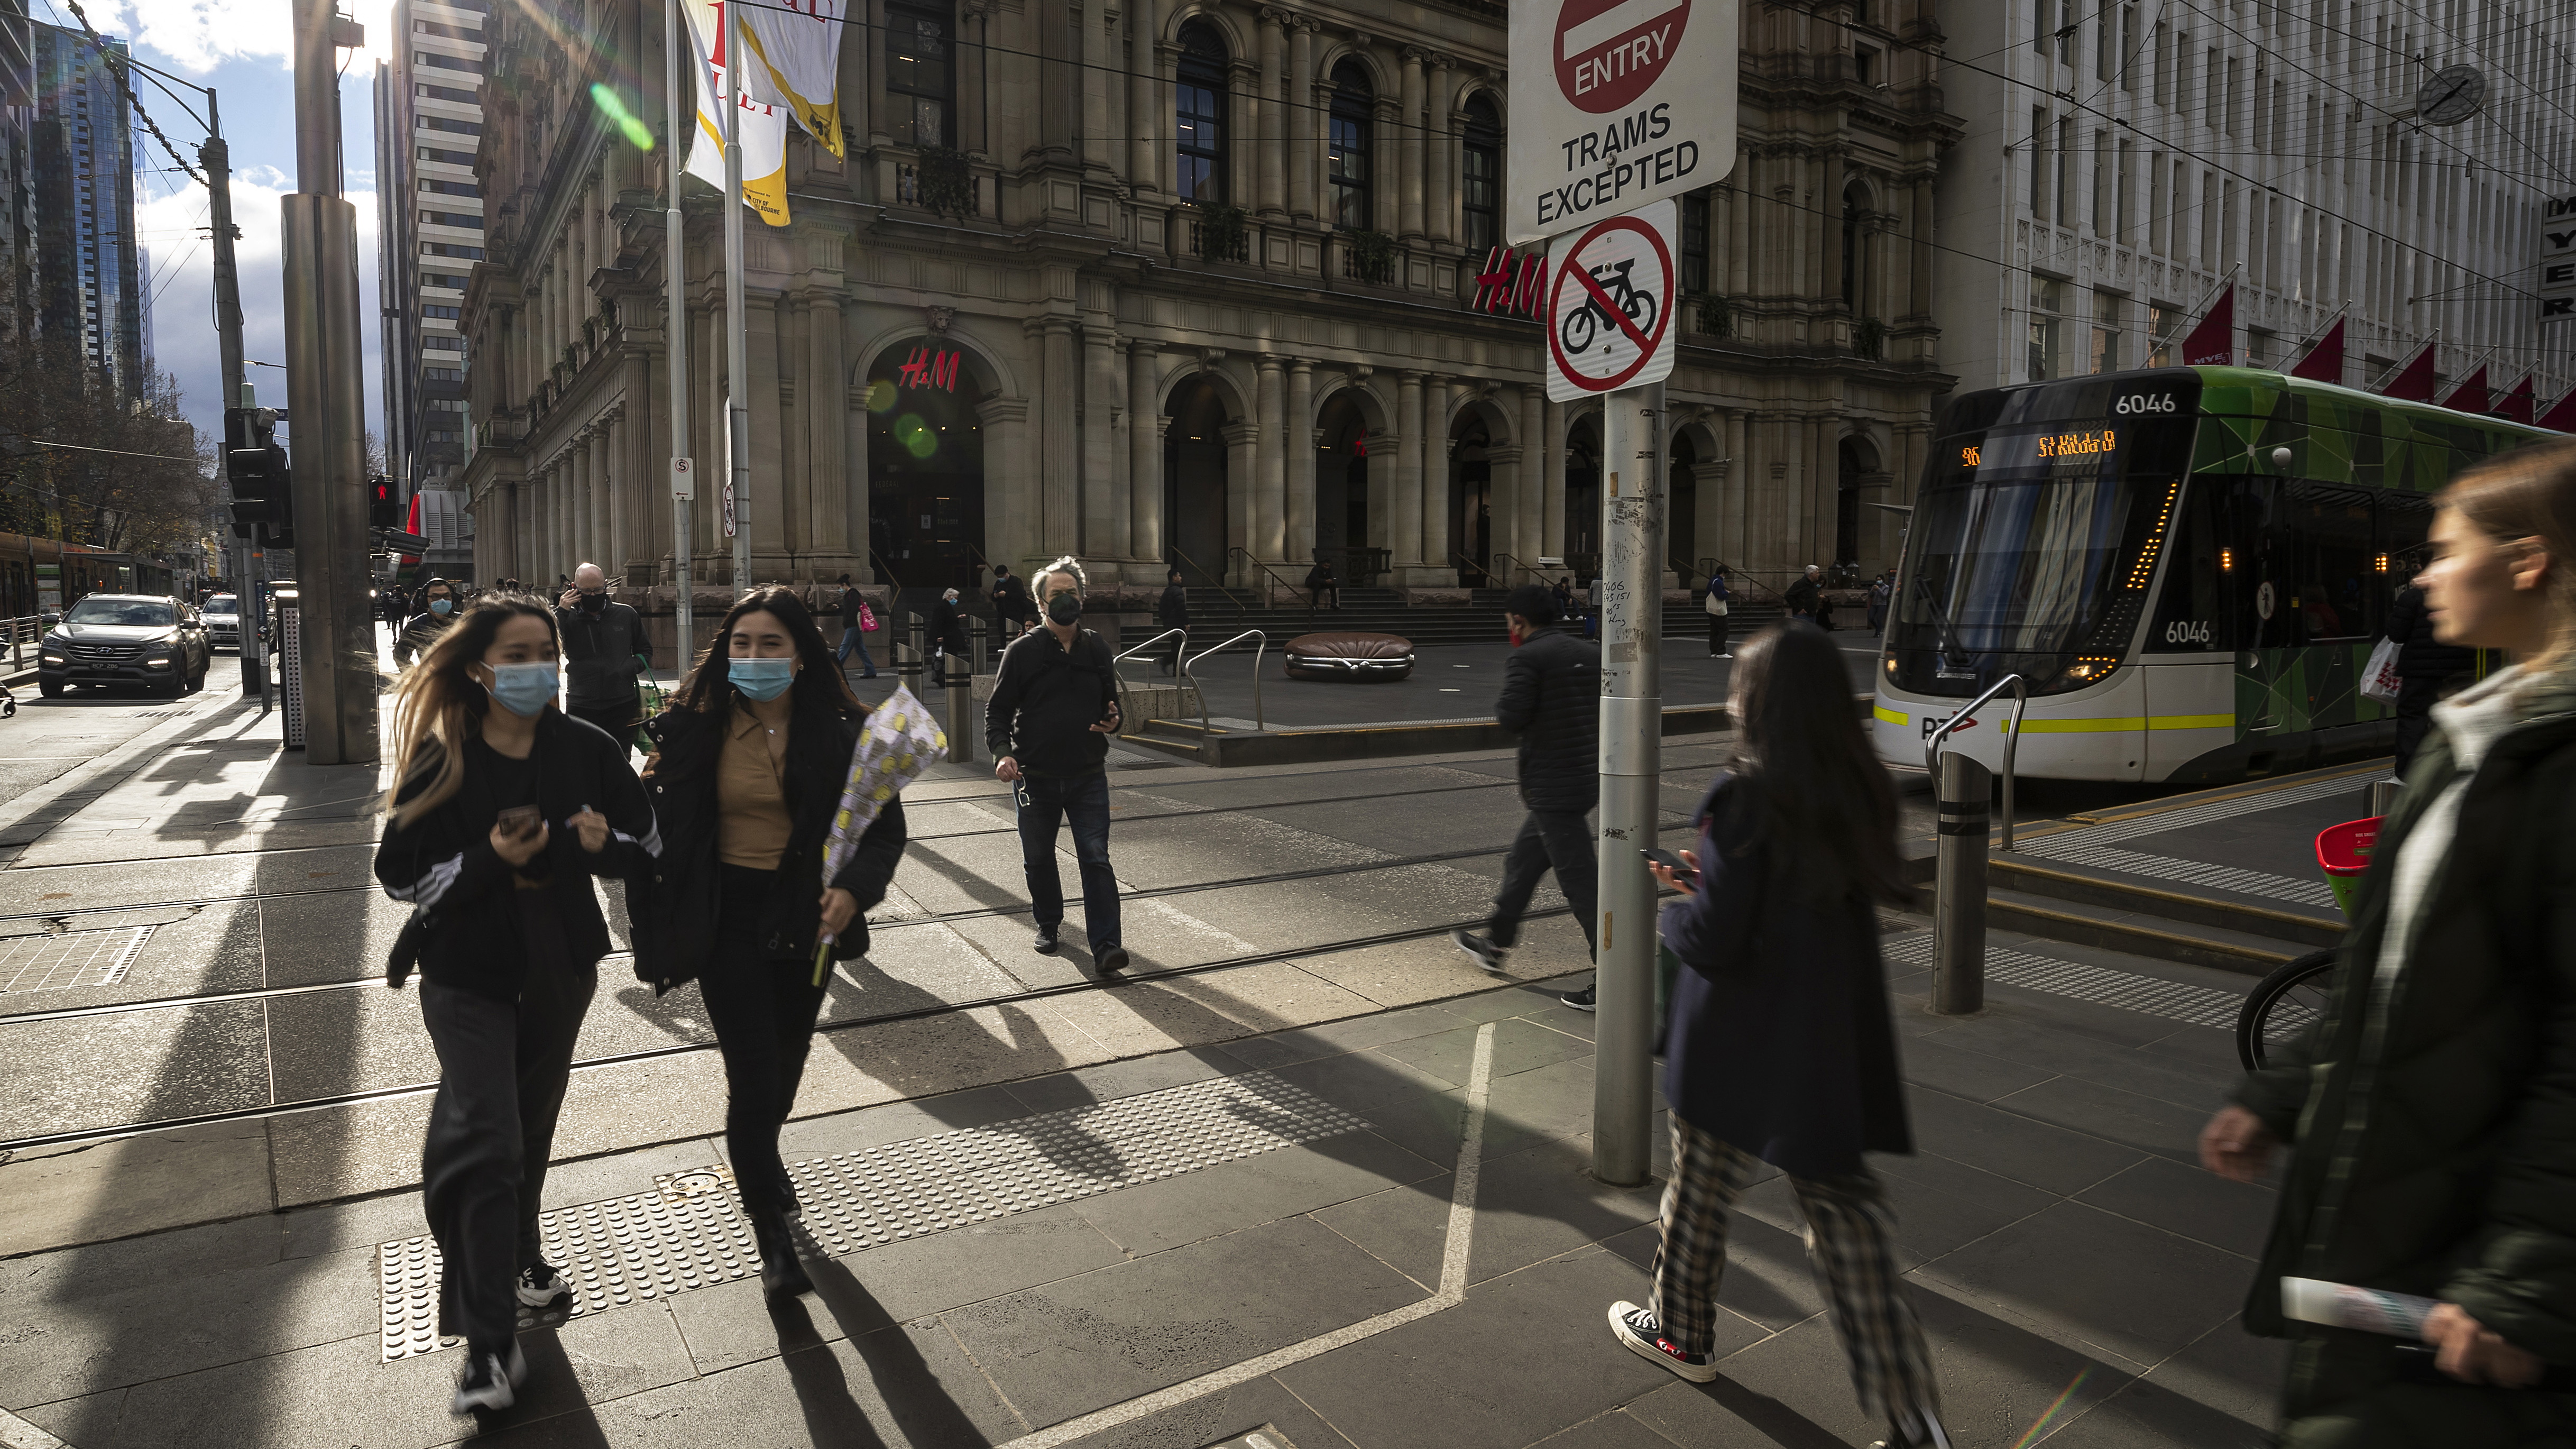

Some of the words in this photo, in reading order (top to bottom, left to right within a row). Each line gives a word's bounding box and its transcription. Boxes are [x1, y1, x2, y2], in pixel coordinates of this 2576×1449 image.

[1576, 23, 1671, 96] ENTRY
[1562, 103, 1670, 172] TRAMS
[1538, 140, 1698, 226] EXCEPTED
[756, 204, 780, 215] ELBOURNE
[1472, 246, 1548, 321] H&M
[899, 346, 960, 393] H&M
[2195, 353, 2223, 365] MYE
[2115, 393, 2176, 414] 6046
[1962, 447, 1981, 466] 96
[2038, 436, 2055, 457] St
[2058, 433, 2100, 455] Kilda
[2166, 621, 2210, 643] 6046
